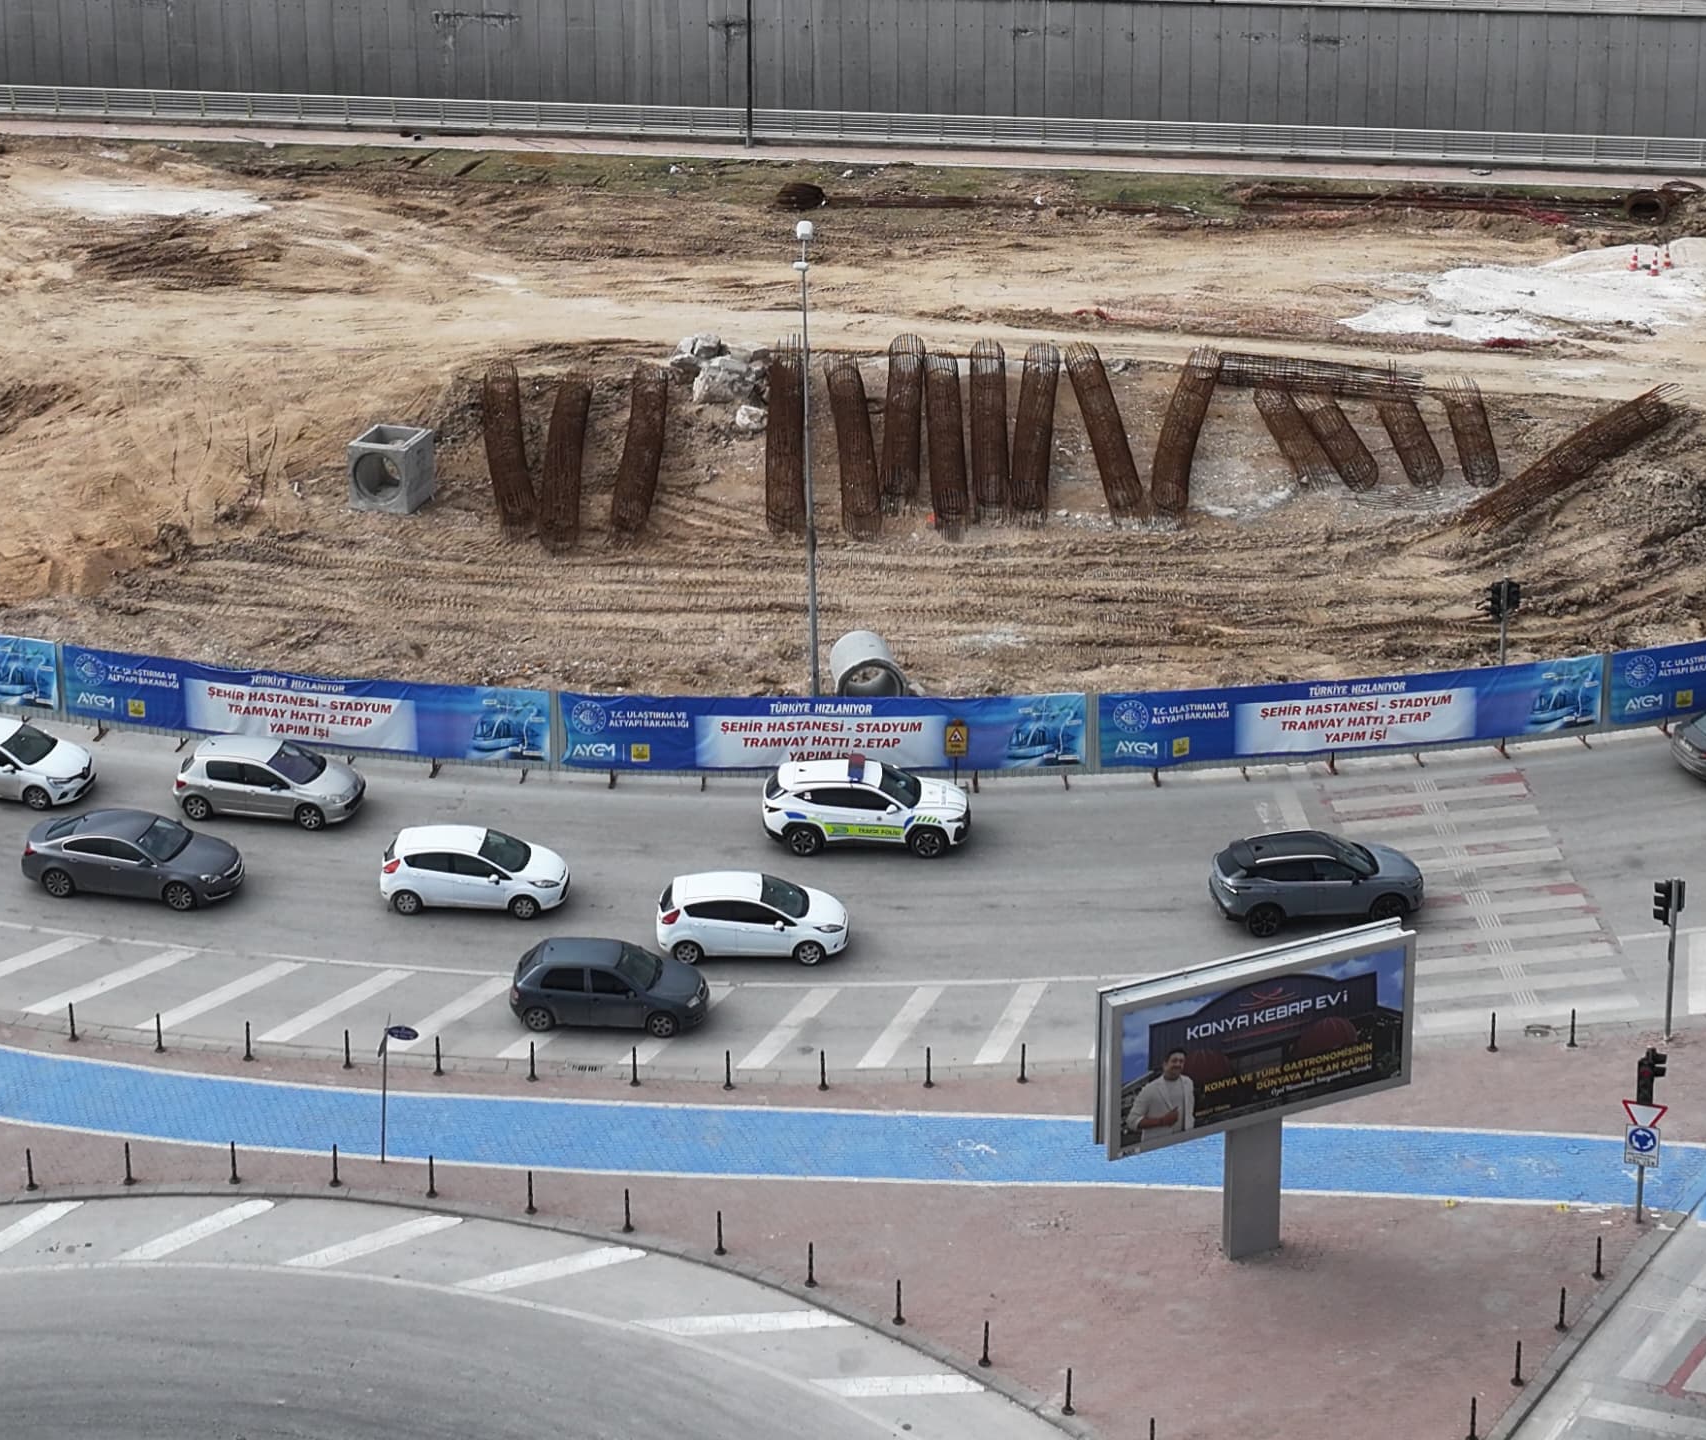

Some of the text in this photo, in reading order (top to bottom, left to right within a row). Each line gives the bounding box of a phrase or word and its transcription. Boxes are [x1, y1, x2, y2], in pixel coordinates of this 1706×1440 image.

[1309, 681, 1406, 697] TÜRKİYE HIZLANIYOR
[207, 686, 245, 701] ŞEHİR
[248, 691, 320, 708] HASTANESİ
[329, 700, 393, 714] STADYUM
[1217, 702, 1228, 710] VE
[1260, 703, 1302, 719] ŞEHİR
[1305, 699, 1379, 716] HASTANESİ
[1389, 694, 1452, 710] STADYUM
[228, 703, 373, 728] TRAMVAY HATTI 2.ETAP
[610, 711, 688, 721] T.C. ULAŞTIRMA VE
[769, 702, 873, 715] TÜRKİYE HIZLANIYOR
[608, 718, 689, 729] ALTYAPI BAKANLIĞI
[720, 719, 763, 735] ŞEHİR
[767, 720, 844, 733] HASTANESİ
[855, 721, 923, 733] STADYUM
[1281, 711, 1432, 732] TRAMVAY HATTI 2.ETAP
[269, 723, 330, 739] YAPIM İŞİ
[1324, 729, 1387, 743] YAPIM İŞİ
[742, 736, 901, 749] TRAMVAY HATTI 2.ETAP
[789, 750, 833, 761] YAPIM
[1186, 1014, 1249, 1041] KONYA
[1253, 999, 1312, 1026] KEBAP
[1204, 1077, 1238, 1093] KONYA
[1240, 1073, 1254, 1084] VE
[1256, 1066, 1282, 1080] TÜRK
[1256, 1072, 1302, 1091] DÜNYAYA
[1342, 1053, 1373, 1070] KAPISI
